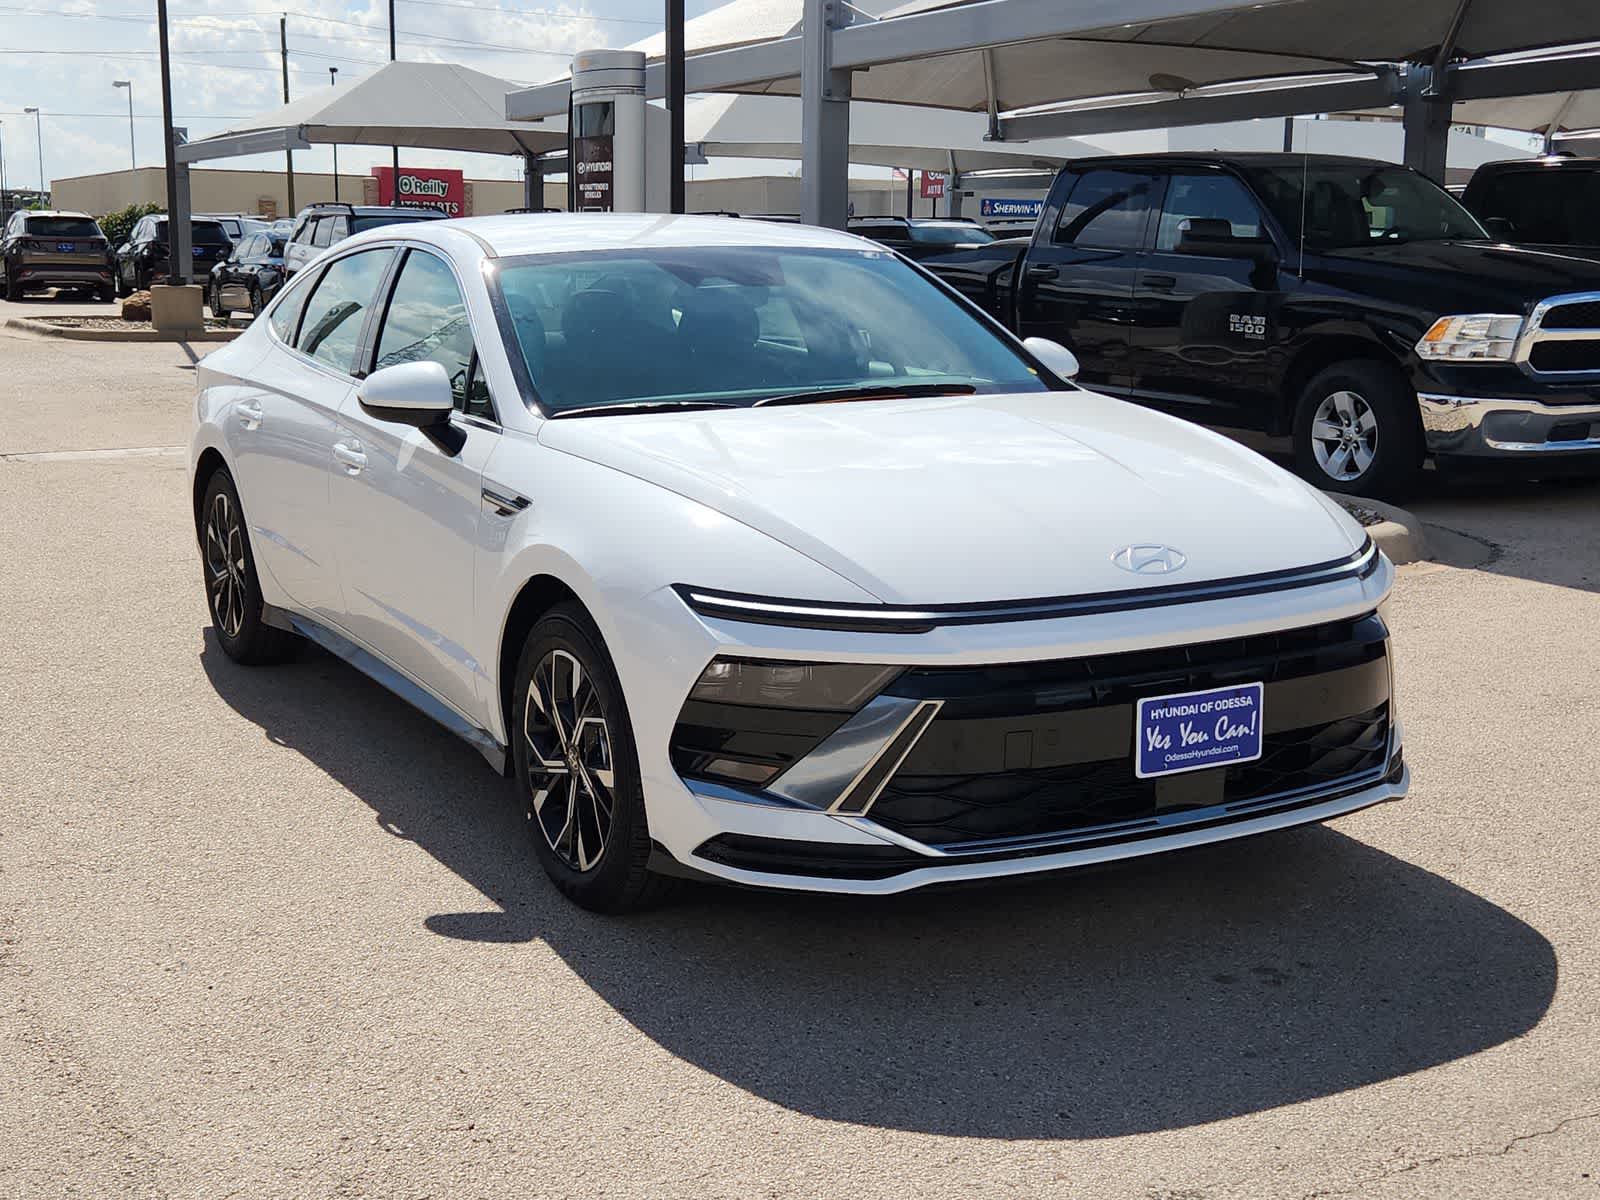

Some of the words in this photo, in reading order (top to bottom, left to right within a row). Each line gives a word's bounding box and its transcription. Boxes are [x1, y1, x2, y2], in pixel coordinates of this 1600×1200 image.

[586, 162, 612, 171] HYUNDAI
[399, 176, 448, 197] O'Reilly
[927, 184, 941, 195] AUTO
[1229, 314, 1266, 325] RAM
[1230, 323, 1265, 334] 1500
[1151, 704, 1198, 720] HYUNDAI
[1200, 701, 1213, 713] OF
[1214, 696, 1253, 709] ODESSA
[1146, 725, 1172, 751] Yes
[1180, 720, 1209, 747] You
[1214, 711, 1256, 741] Can!
[1164, 744, 1239, 762] OdessaHyundai.com
